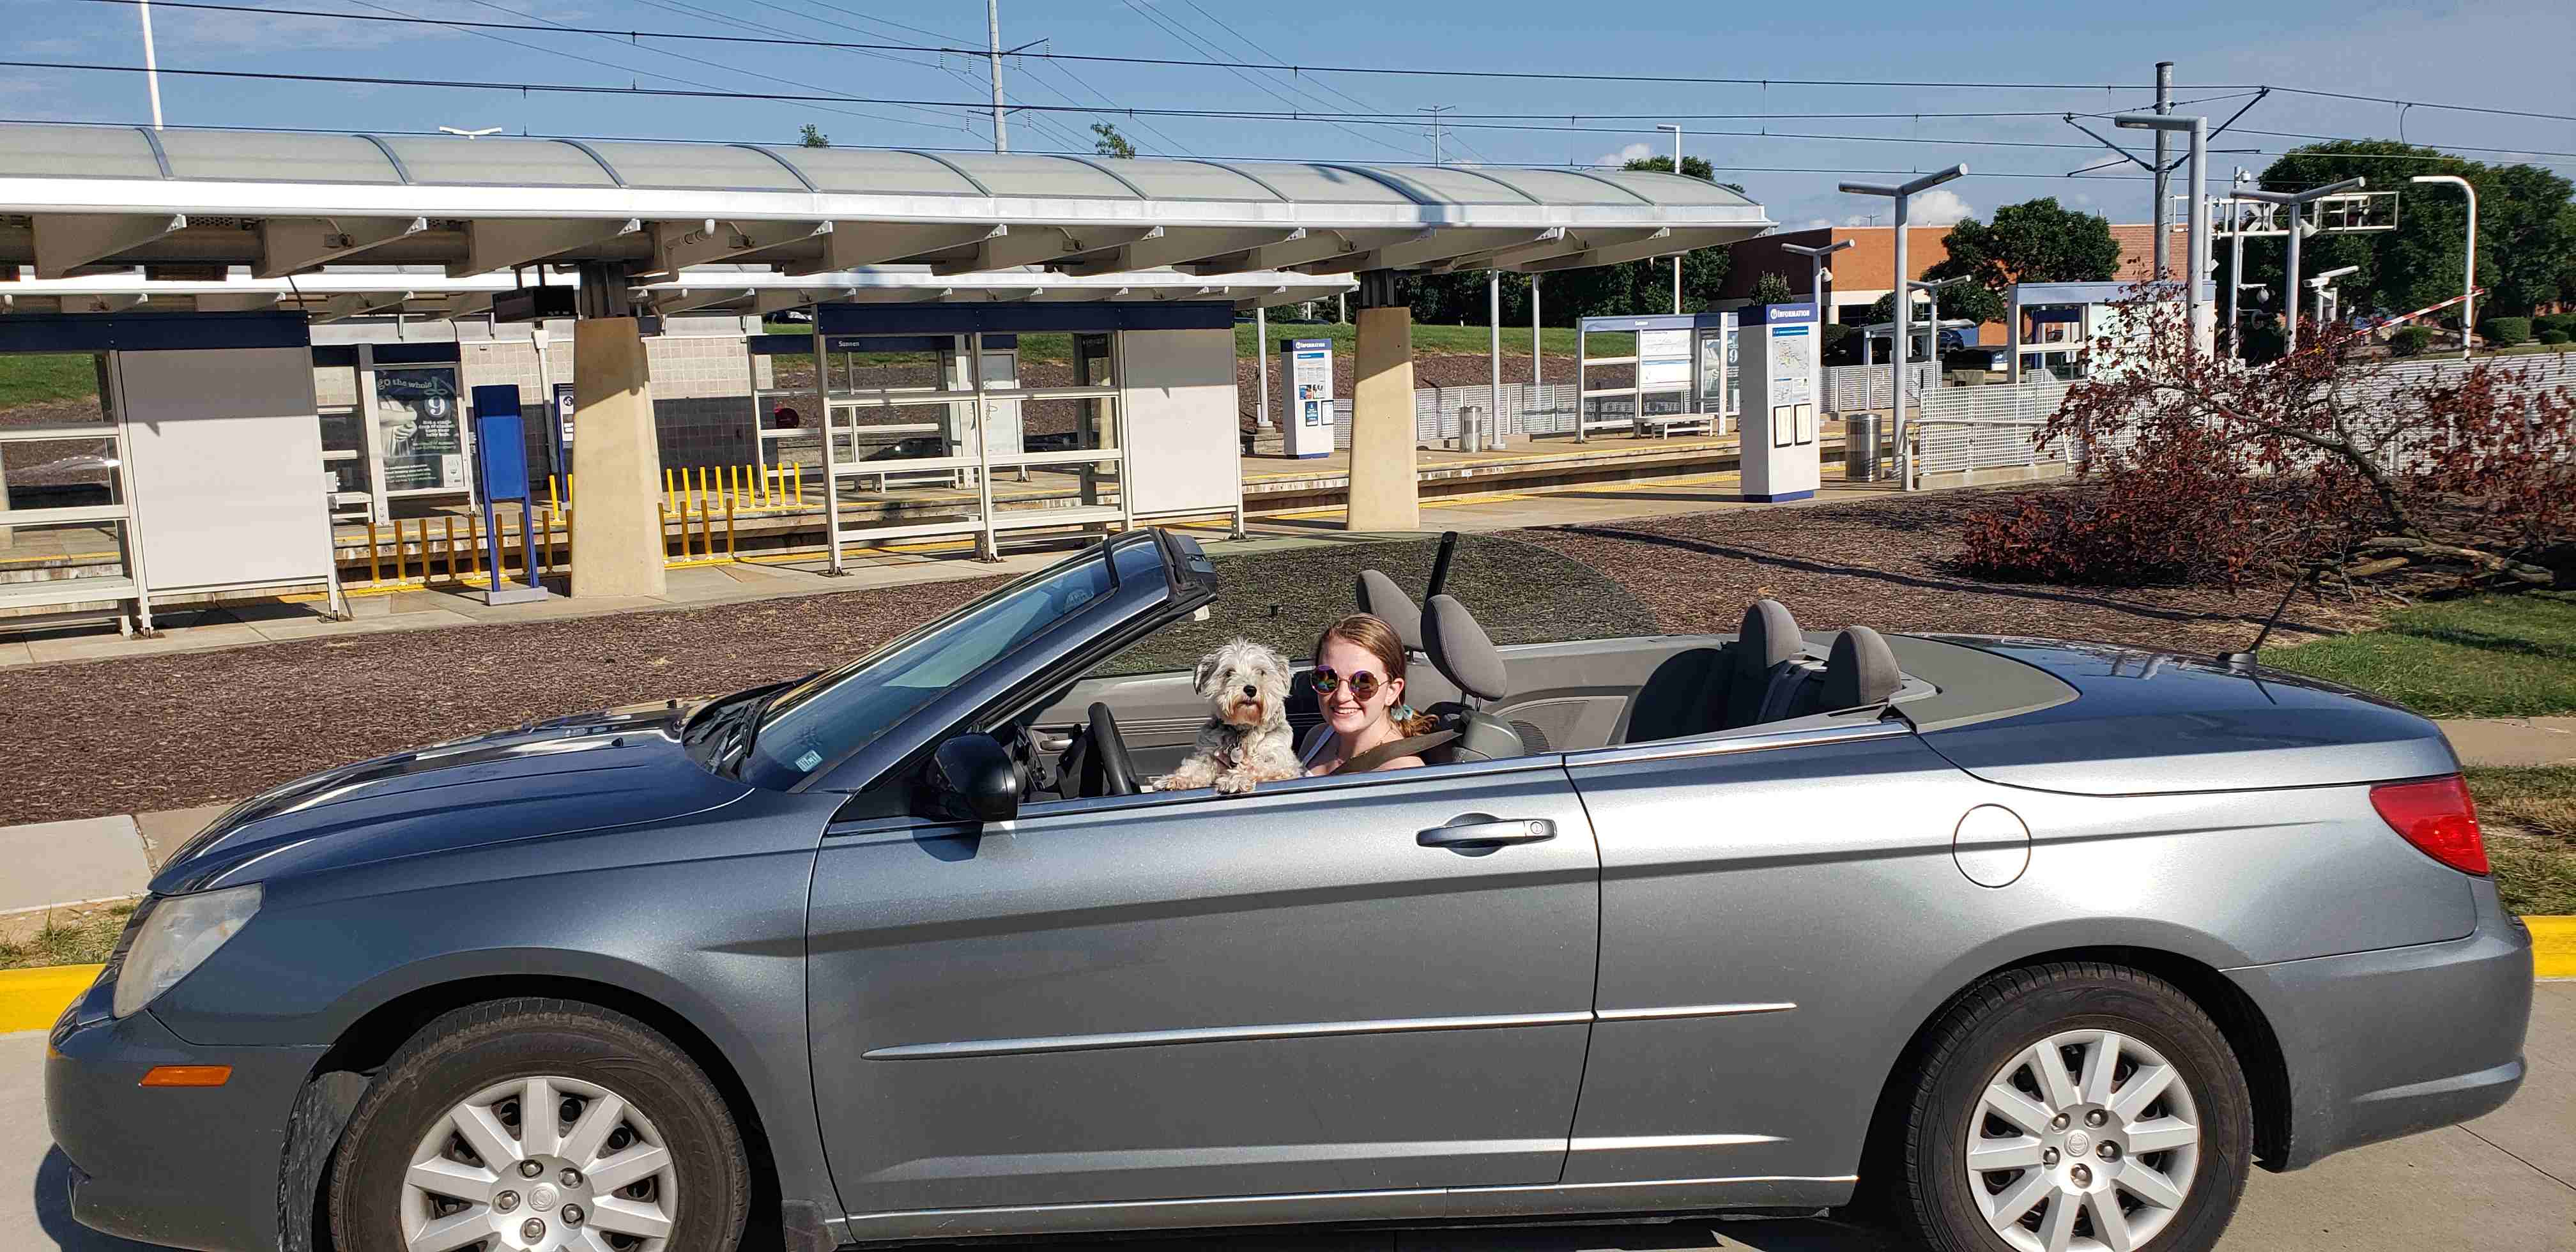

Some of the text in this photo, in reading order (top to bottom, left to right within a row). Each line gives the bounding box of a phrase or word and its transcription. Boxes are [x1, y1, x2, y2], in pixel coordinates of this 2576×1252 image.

[1777, 309, 1810, 317] INFORMATION
[1729, 349, 1738, 363] 9
[378, 378, 391, 390] go
[393, 378, 407, 386] the
[428, 398, 445, 415] 9
